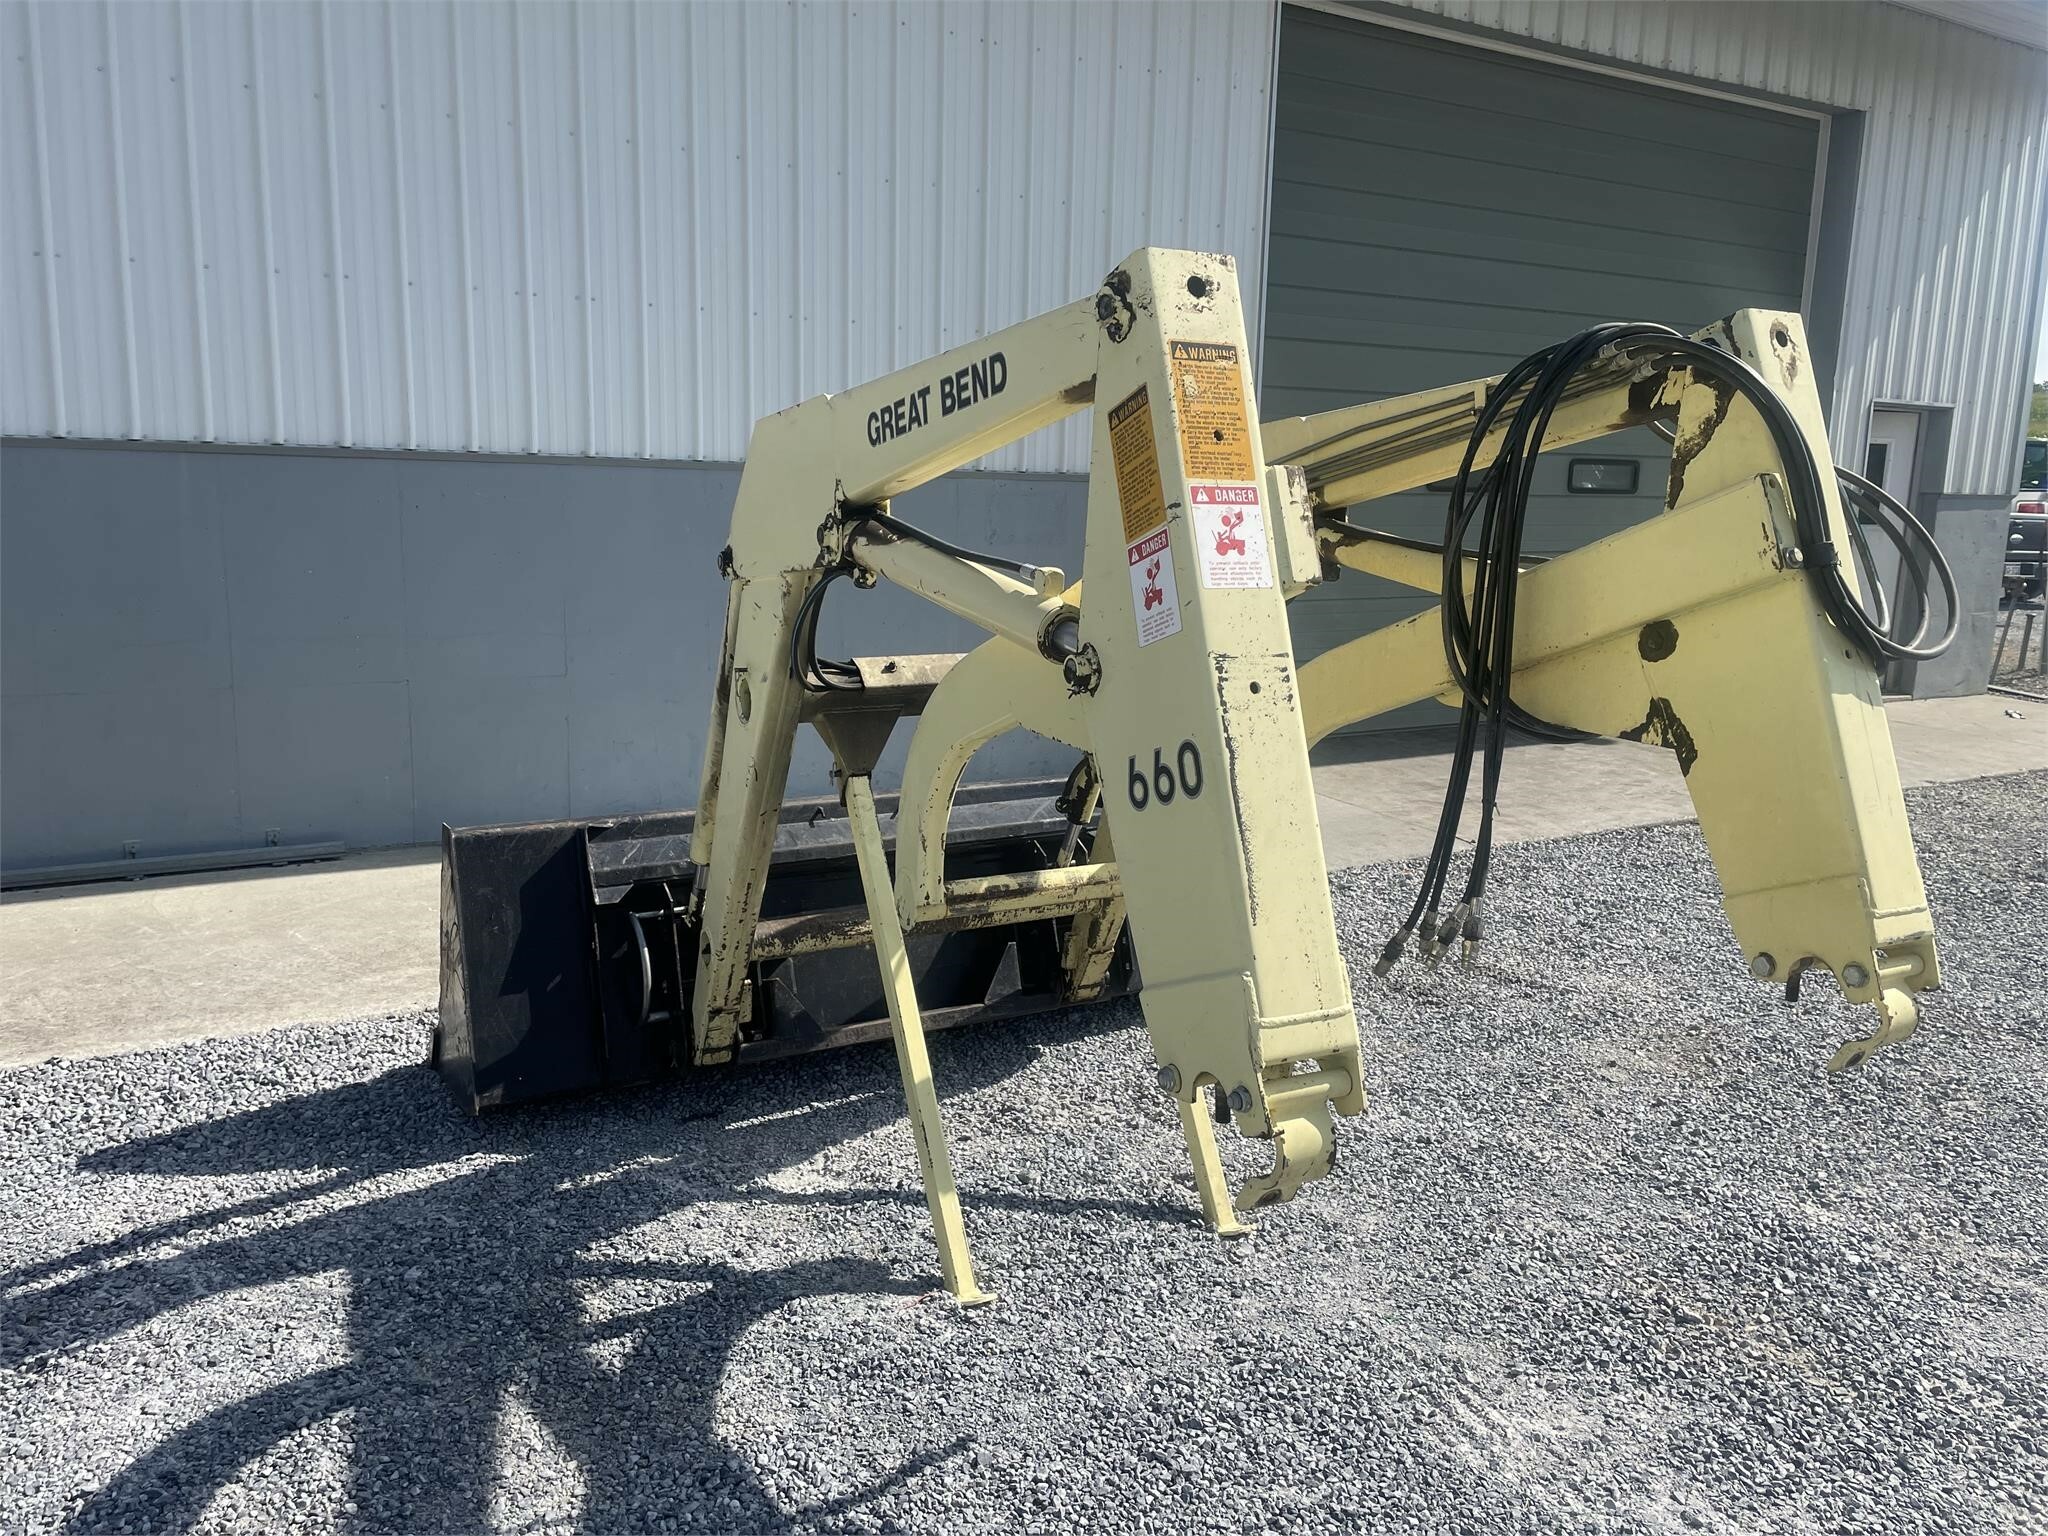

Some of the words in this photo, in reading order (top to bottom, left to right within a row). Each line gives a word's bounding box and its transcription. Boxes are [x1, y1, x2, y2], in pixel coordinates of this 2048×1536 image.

[1188, 347, 1236, 364] WARNING
[867, 385, 931, 448] GREAT
[940, 351, 1008, 417] BEND
[1118, 391, 1147, 422] WARNING
[1215, 489, 1255, 503] DANGER
[1141, 534, 1167, 556] DANGER
[1128, 738, 1203, 812] 660
